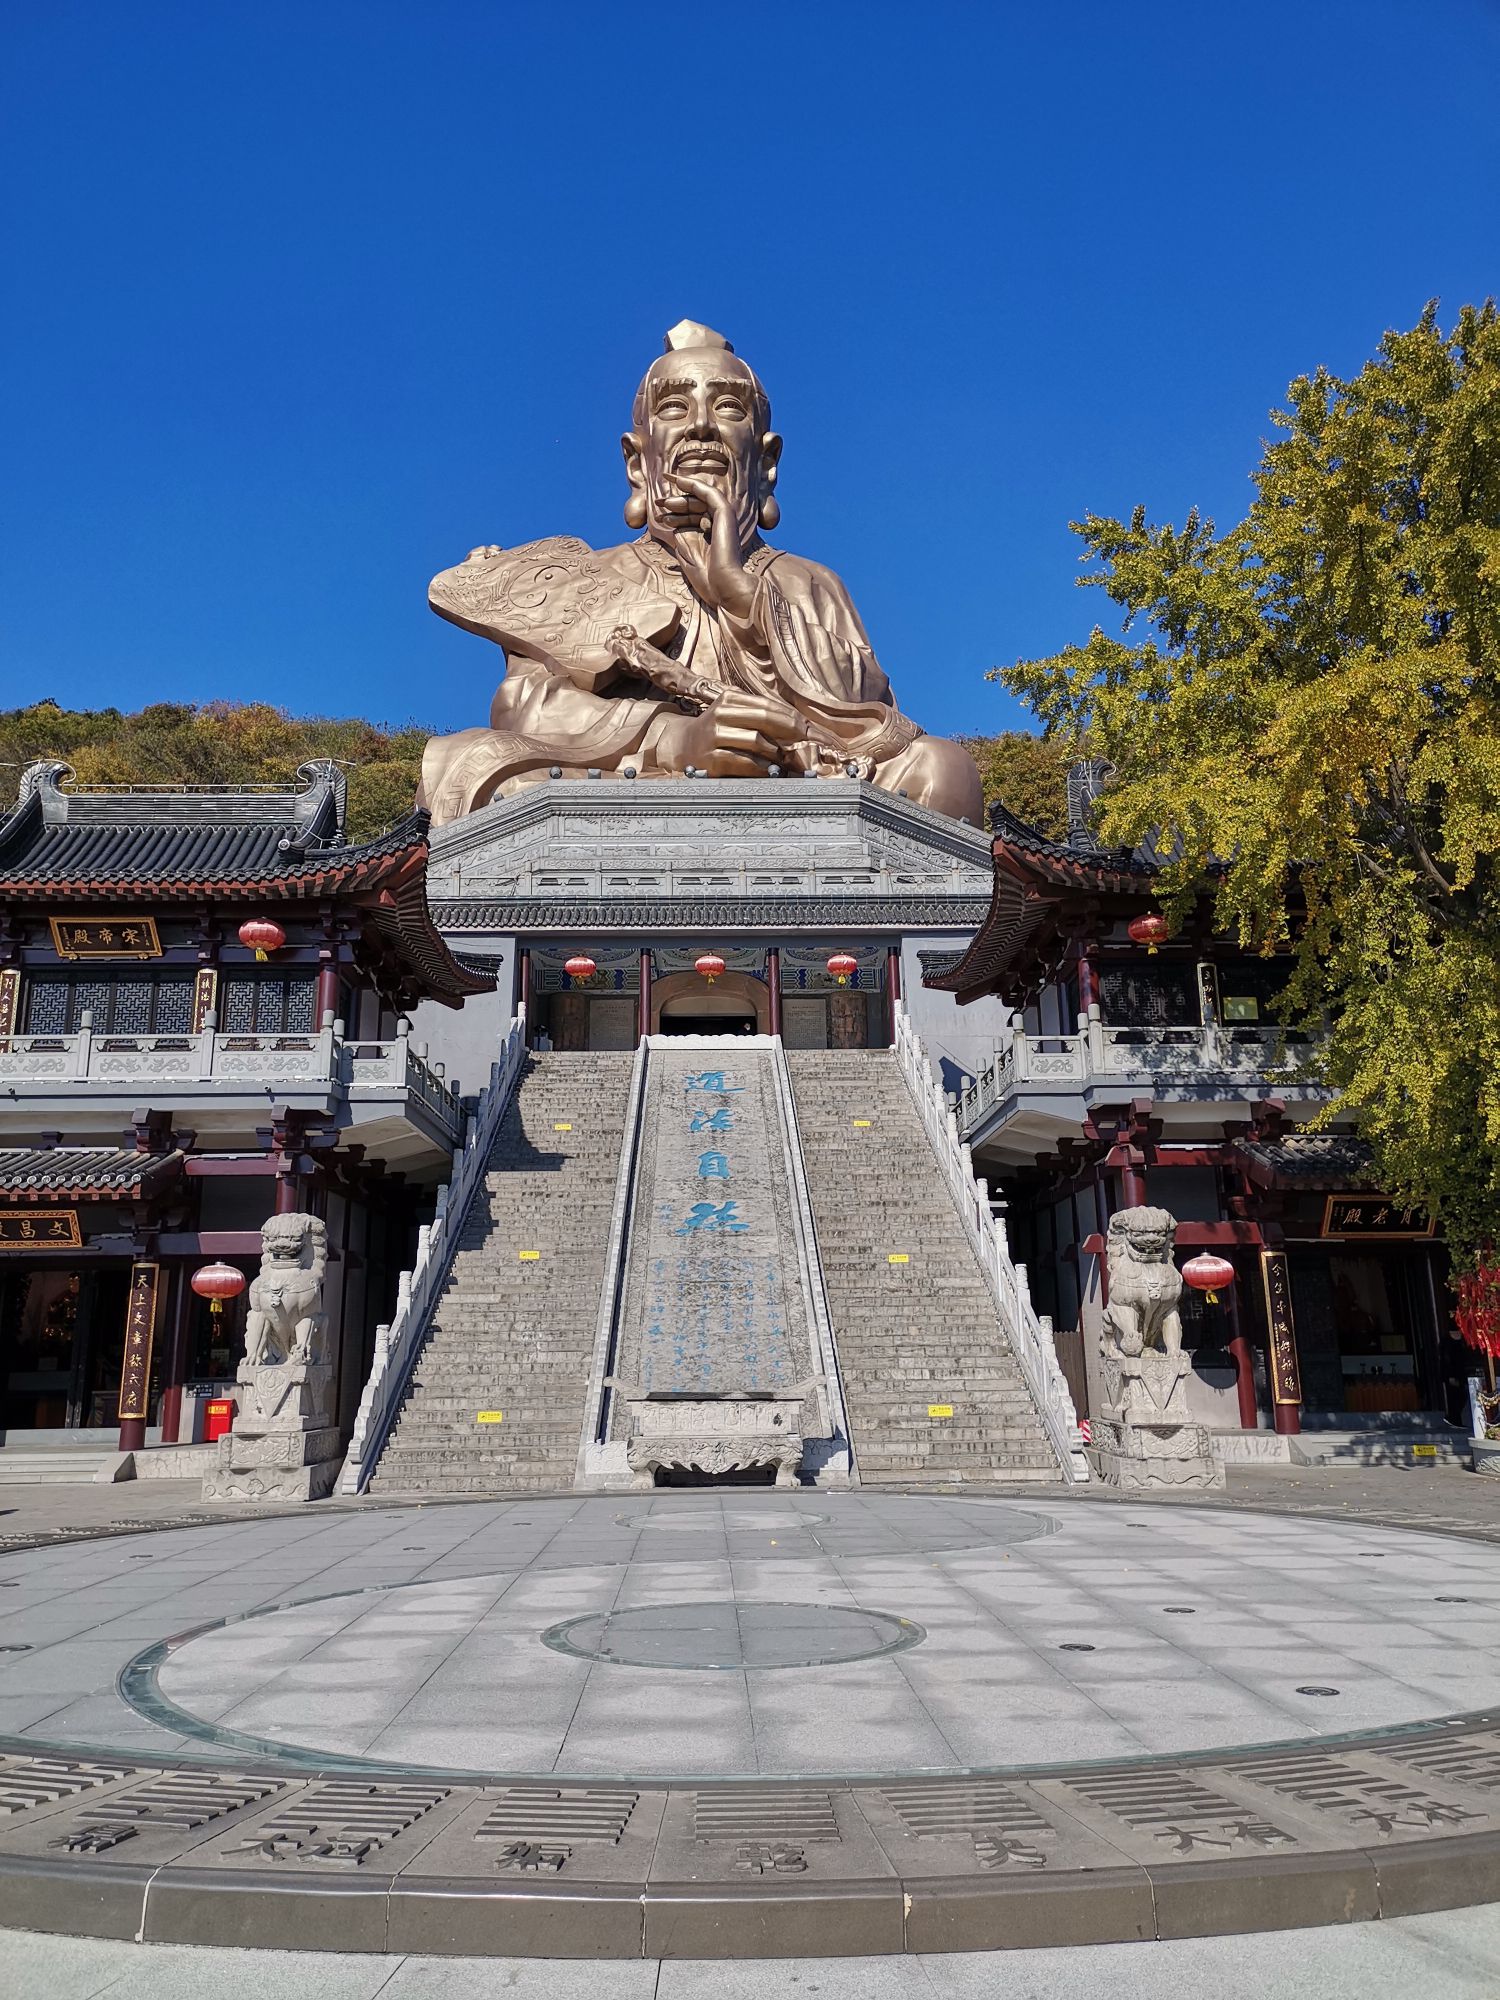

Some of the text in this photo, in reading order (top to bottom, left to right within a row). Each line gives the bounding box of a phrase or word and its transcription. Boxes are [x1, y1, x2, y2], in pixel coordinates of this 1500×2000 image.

[675, 1071, 751, 1236] 道法自然
[1152, 1821, 1299, 1856] 大有
